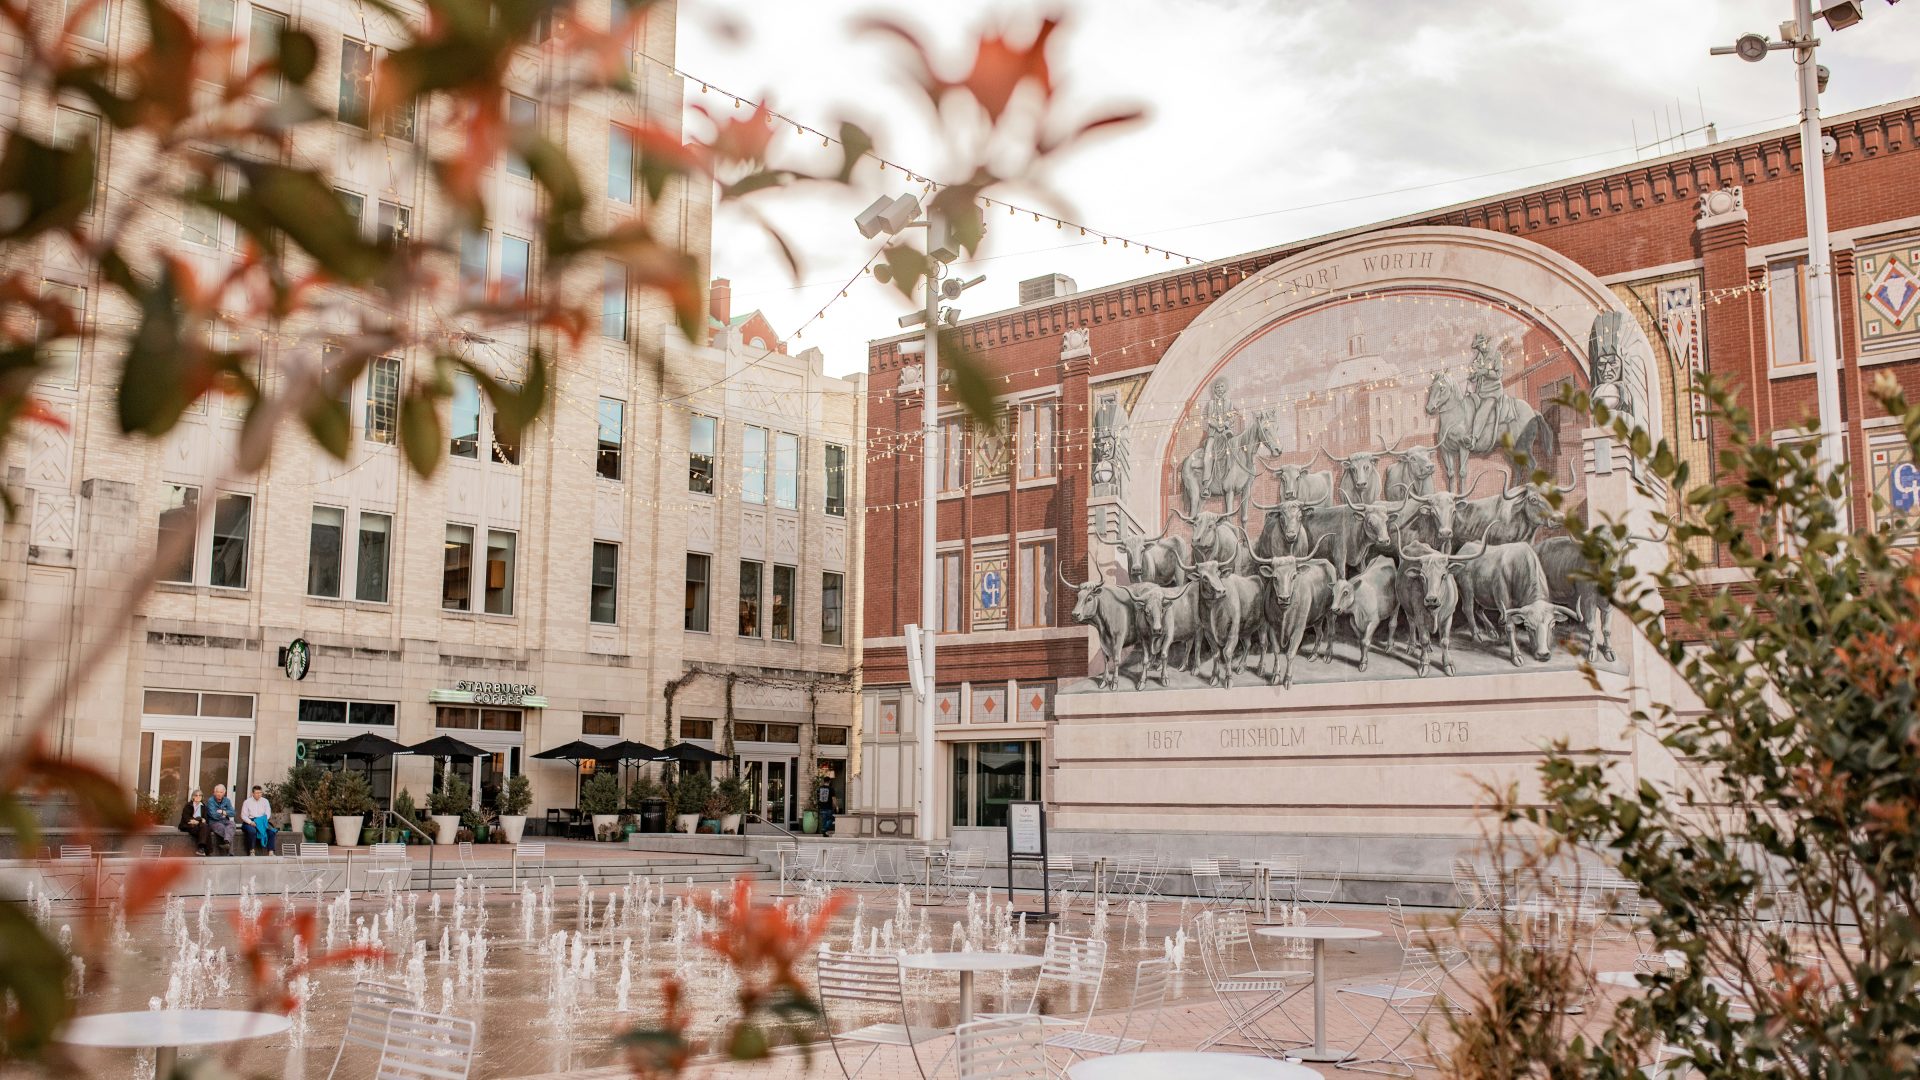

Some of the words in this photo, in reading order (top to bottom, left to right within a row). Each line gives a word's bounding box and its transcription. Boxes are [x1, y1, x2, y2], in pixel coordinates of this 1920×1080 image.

[1291, 264, 1340, 293] FORT
[1361, 251, 1433, 273] WORTH
[457, 680, 537, 696] STARBUCKS
[474, 692, 523, 705] COFFEE
[1220, 726, 1306, 749] CHISHOLM
[1326, 724, 1384, 745] TRAIL
[1423, 721, 1470, 744] 1875
